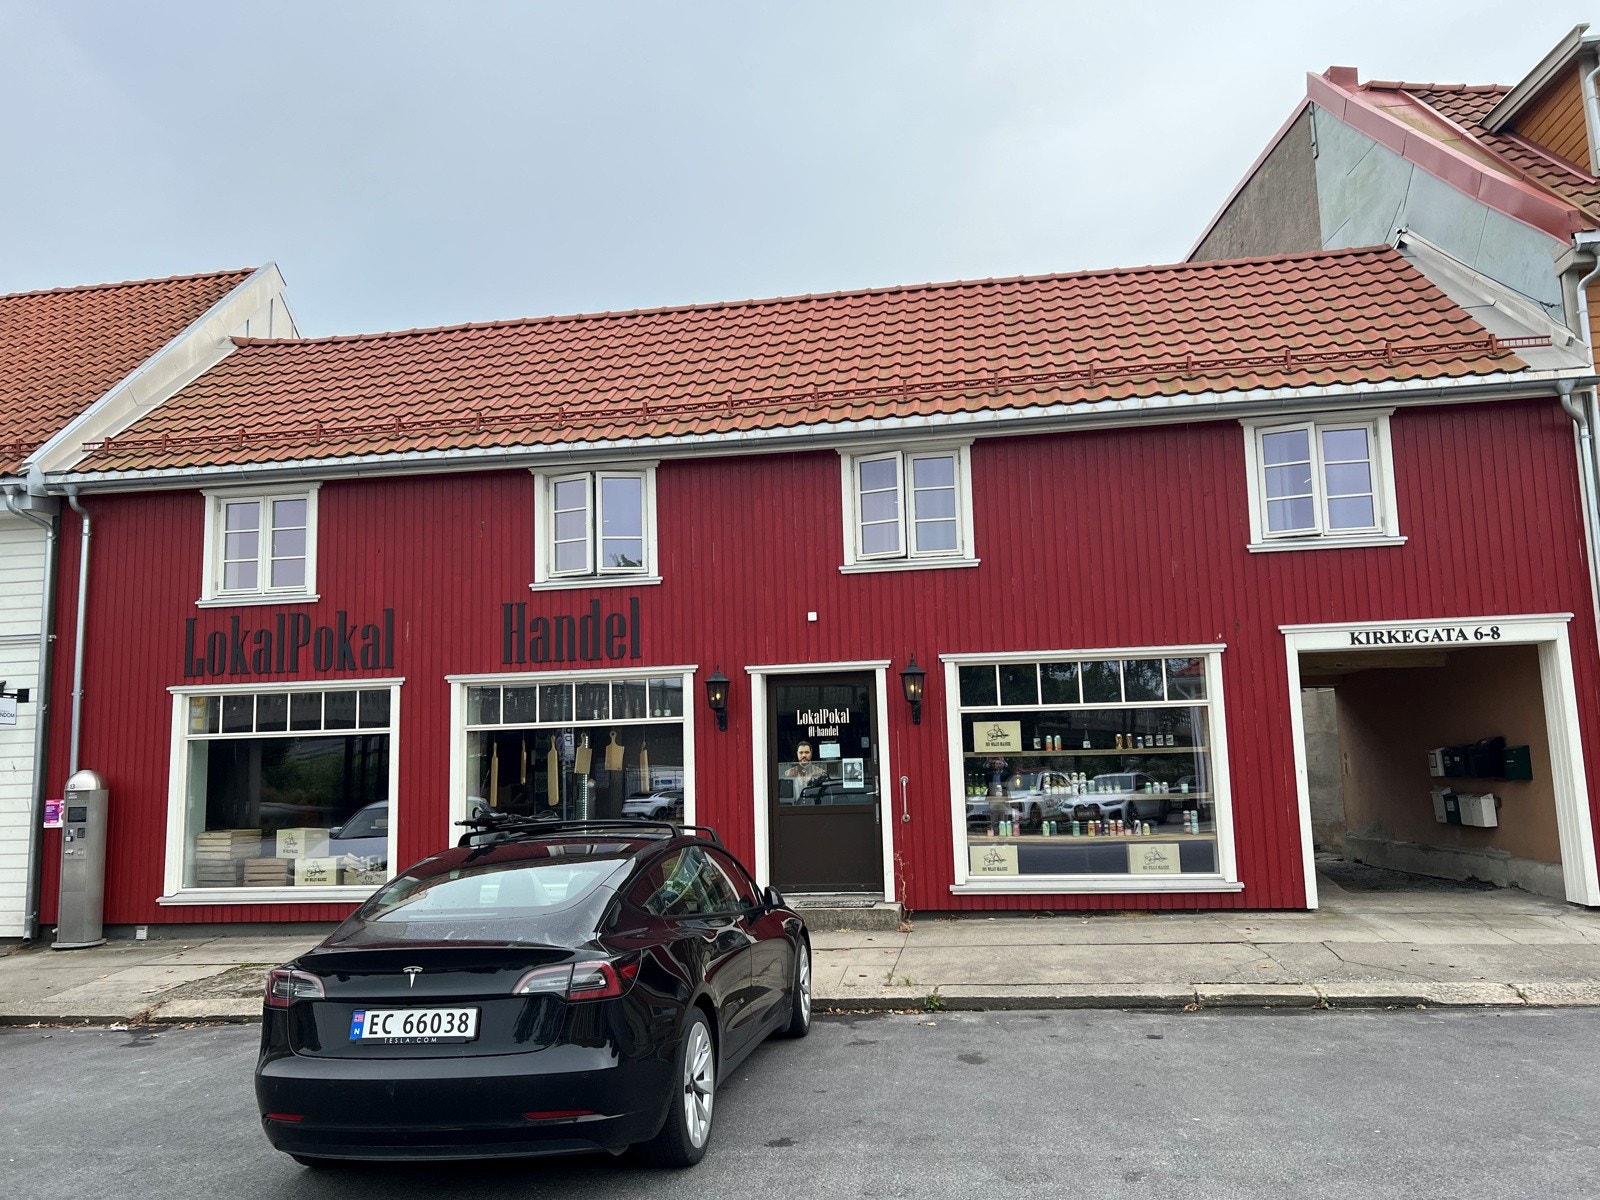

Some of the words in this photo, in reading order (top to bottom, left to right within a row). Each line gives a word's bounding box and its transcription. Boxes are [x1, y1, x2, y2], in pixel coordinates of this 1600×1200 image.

[502, 597, 641, 664] Handel
[1349, 627, 1469, 646] KIRKEGATA
[1473, 626, 1501, 640] 6-8
[183, 608, 394, 677] LokalPokal
[796, 707, 850, 725] LokalPokal
[368, 1013, 395, 1035] EC
[402, 1012, 469, 1034] 66038
